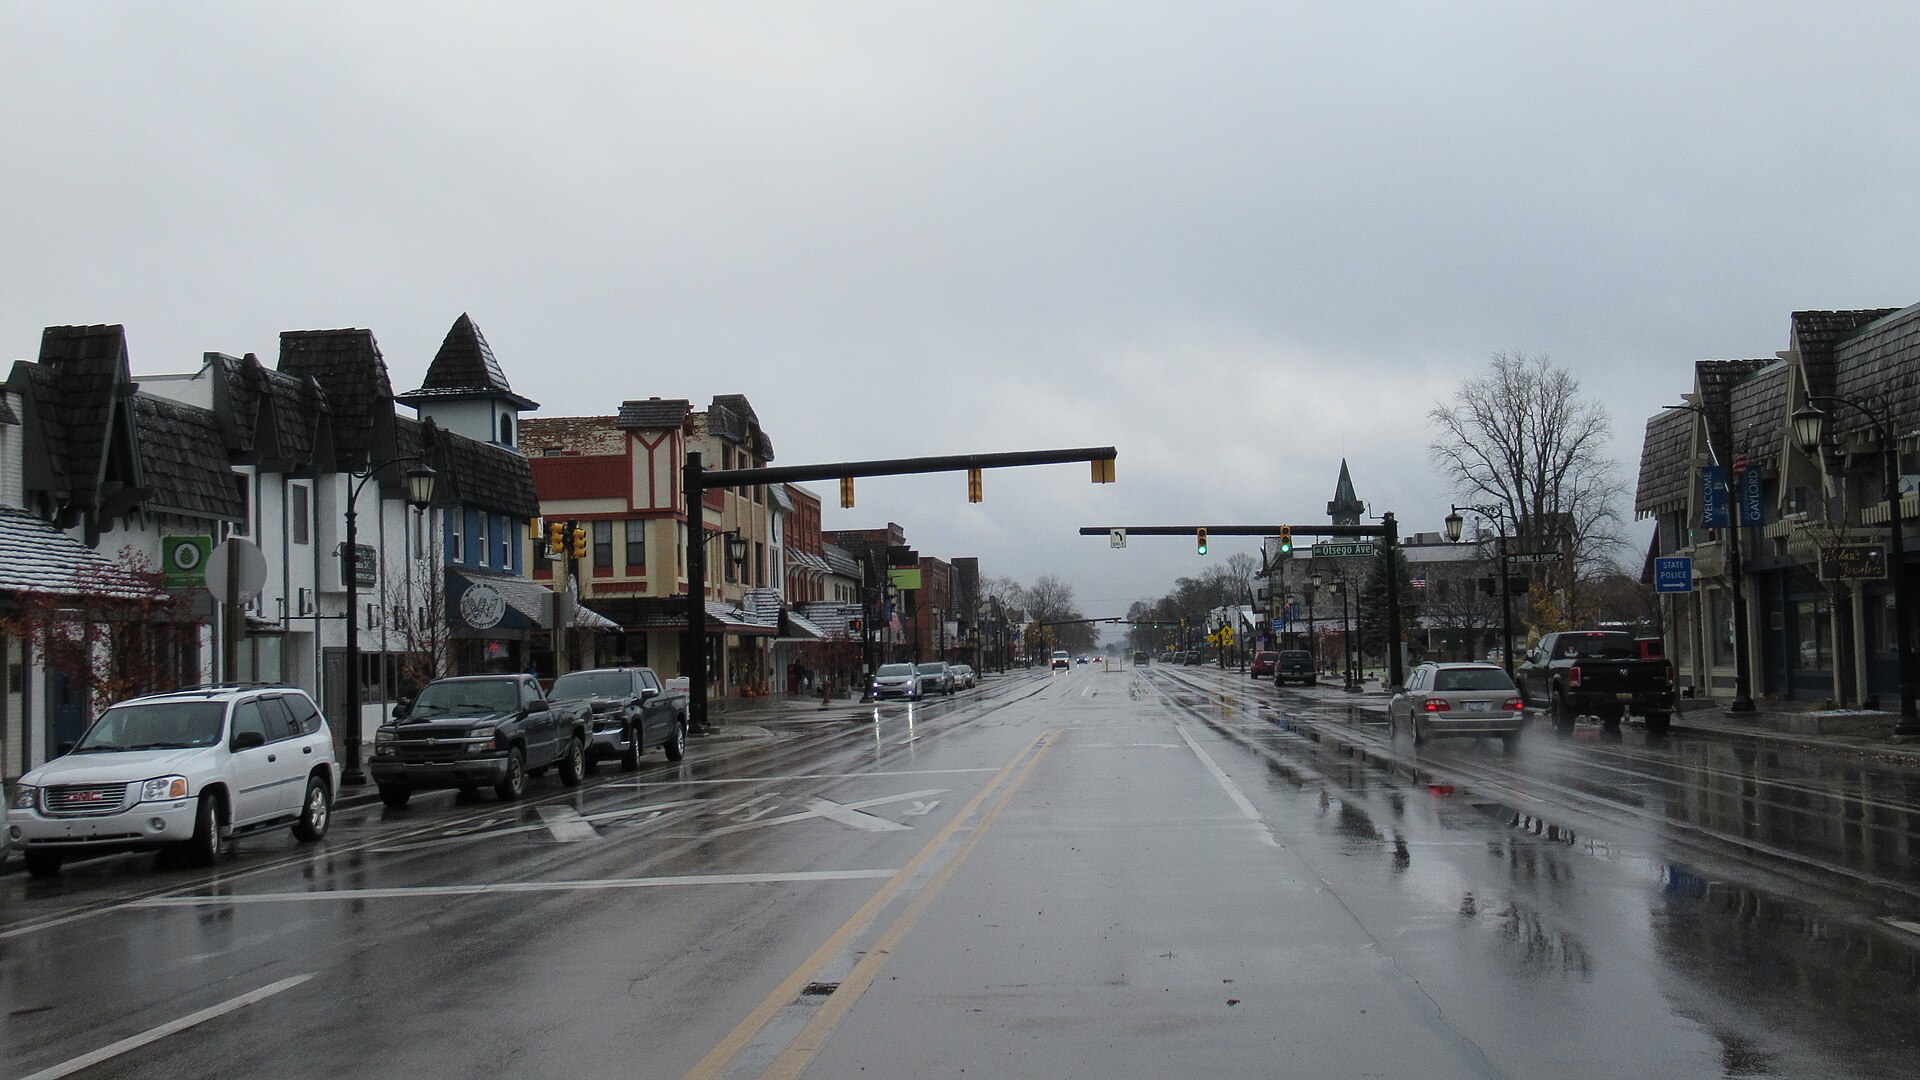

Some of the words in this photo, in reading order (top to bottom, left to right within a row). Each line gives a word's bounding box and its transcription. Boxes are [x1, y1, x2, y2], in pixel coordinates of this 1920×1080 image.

[1703, 472, 1713, 523] WELCOME
[1748, 470, 1761, 521] GAYLORD
[1322, 545, 1352, 556] Otsego
[1355, 545, 1371, 554] Ave
[1516, 554, 1534, 563] DINING
[1540, 553, 1558, 562] SHOPS
[1662, 561, 1685, 569] STATE
[1660, 571, 1687, 579] POLICE
[66, 791, 103, 802] GMC
